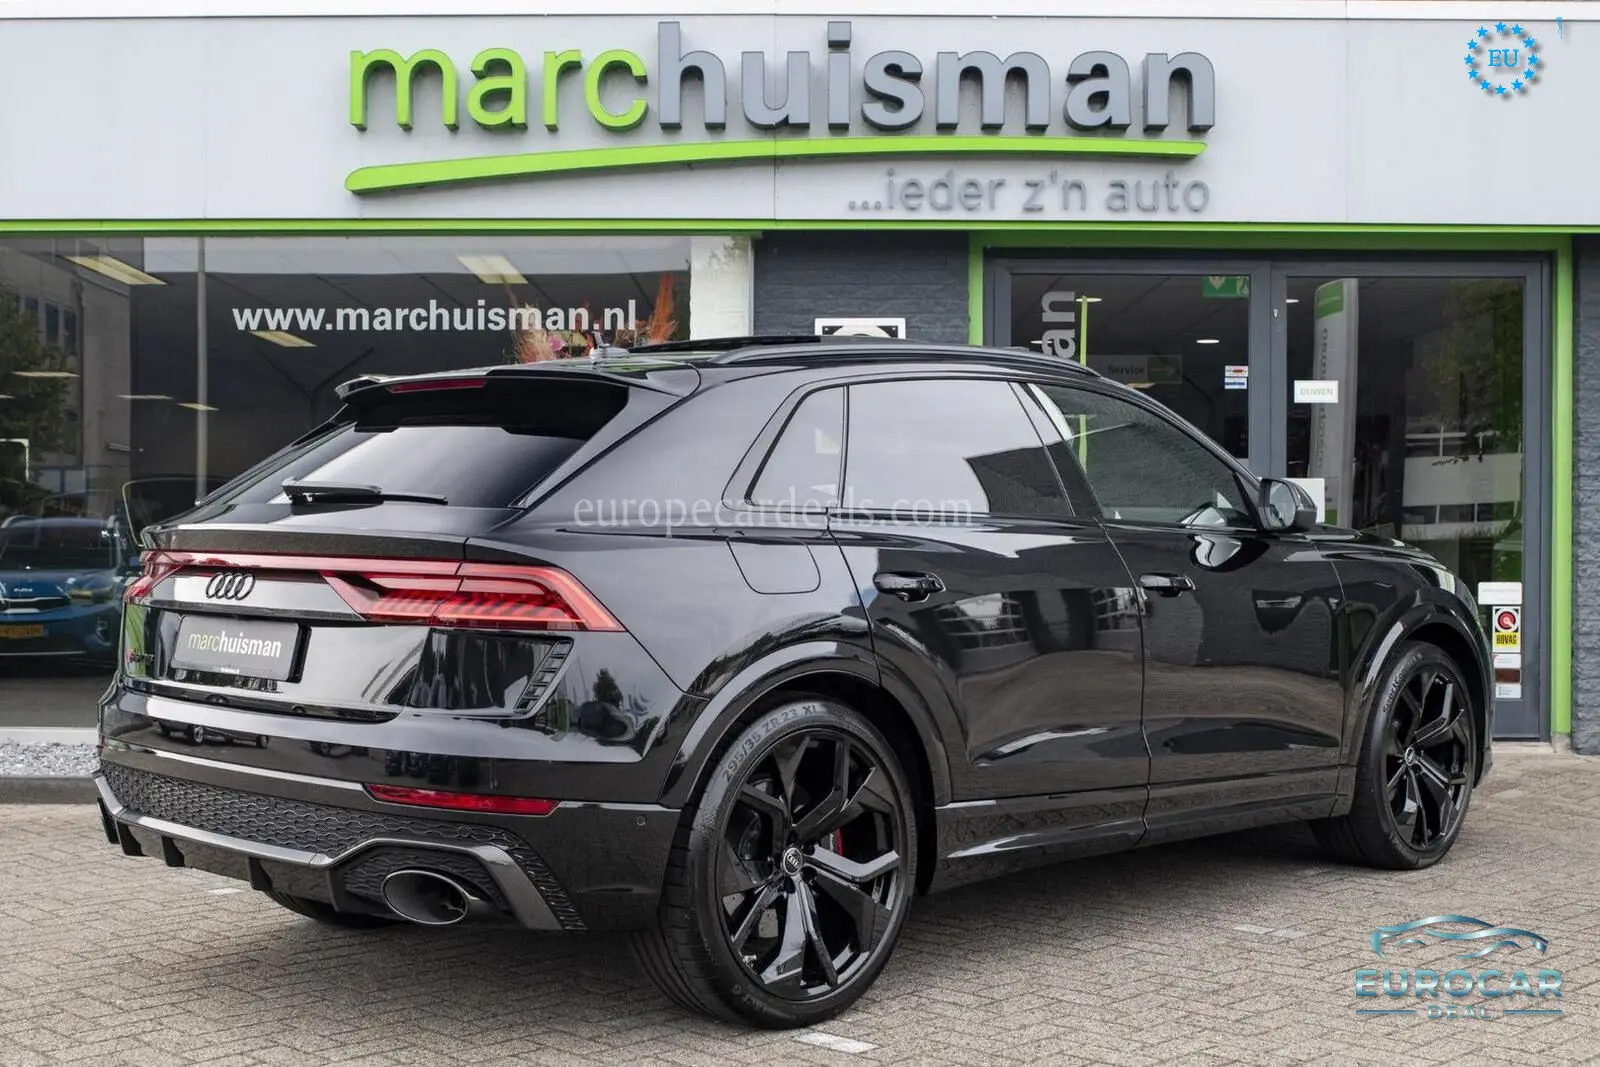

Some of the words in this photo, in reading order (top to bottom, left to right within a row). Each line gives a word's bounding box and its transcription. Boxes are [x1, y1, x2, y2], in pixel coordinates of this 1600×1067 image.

[350, 21, 1215, 133] marchuisman
[848, 168, 1005, 213] ...ieder
[1022, 169, 1087, 213] z'n
[1105, 171, 1211, 213] auto
[232, 299, 636, 332] www.marchuisman.nl
[1107, 364, 1145, 375] Service
[1299, 387, 1334, 396] DUWEN
[187, 629, 282, 658] marchuisman
[1495, 634, 1517, 645] BOVAG
[762, 716, 780, 733] ZR
[780, 708, 798, 720] 23
